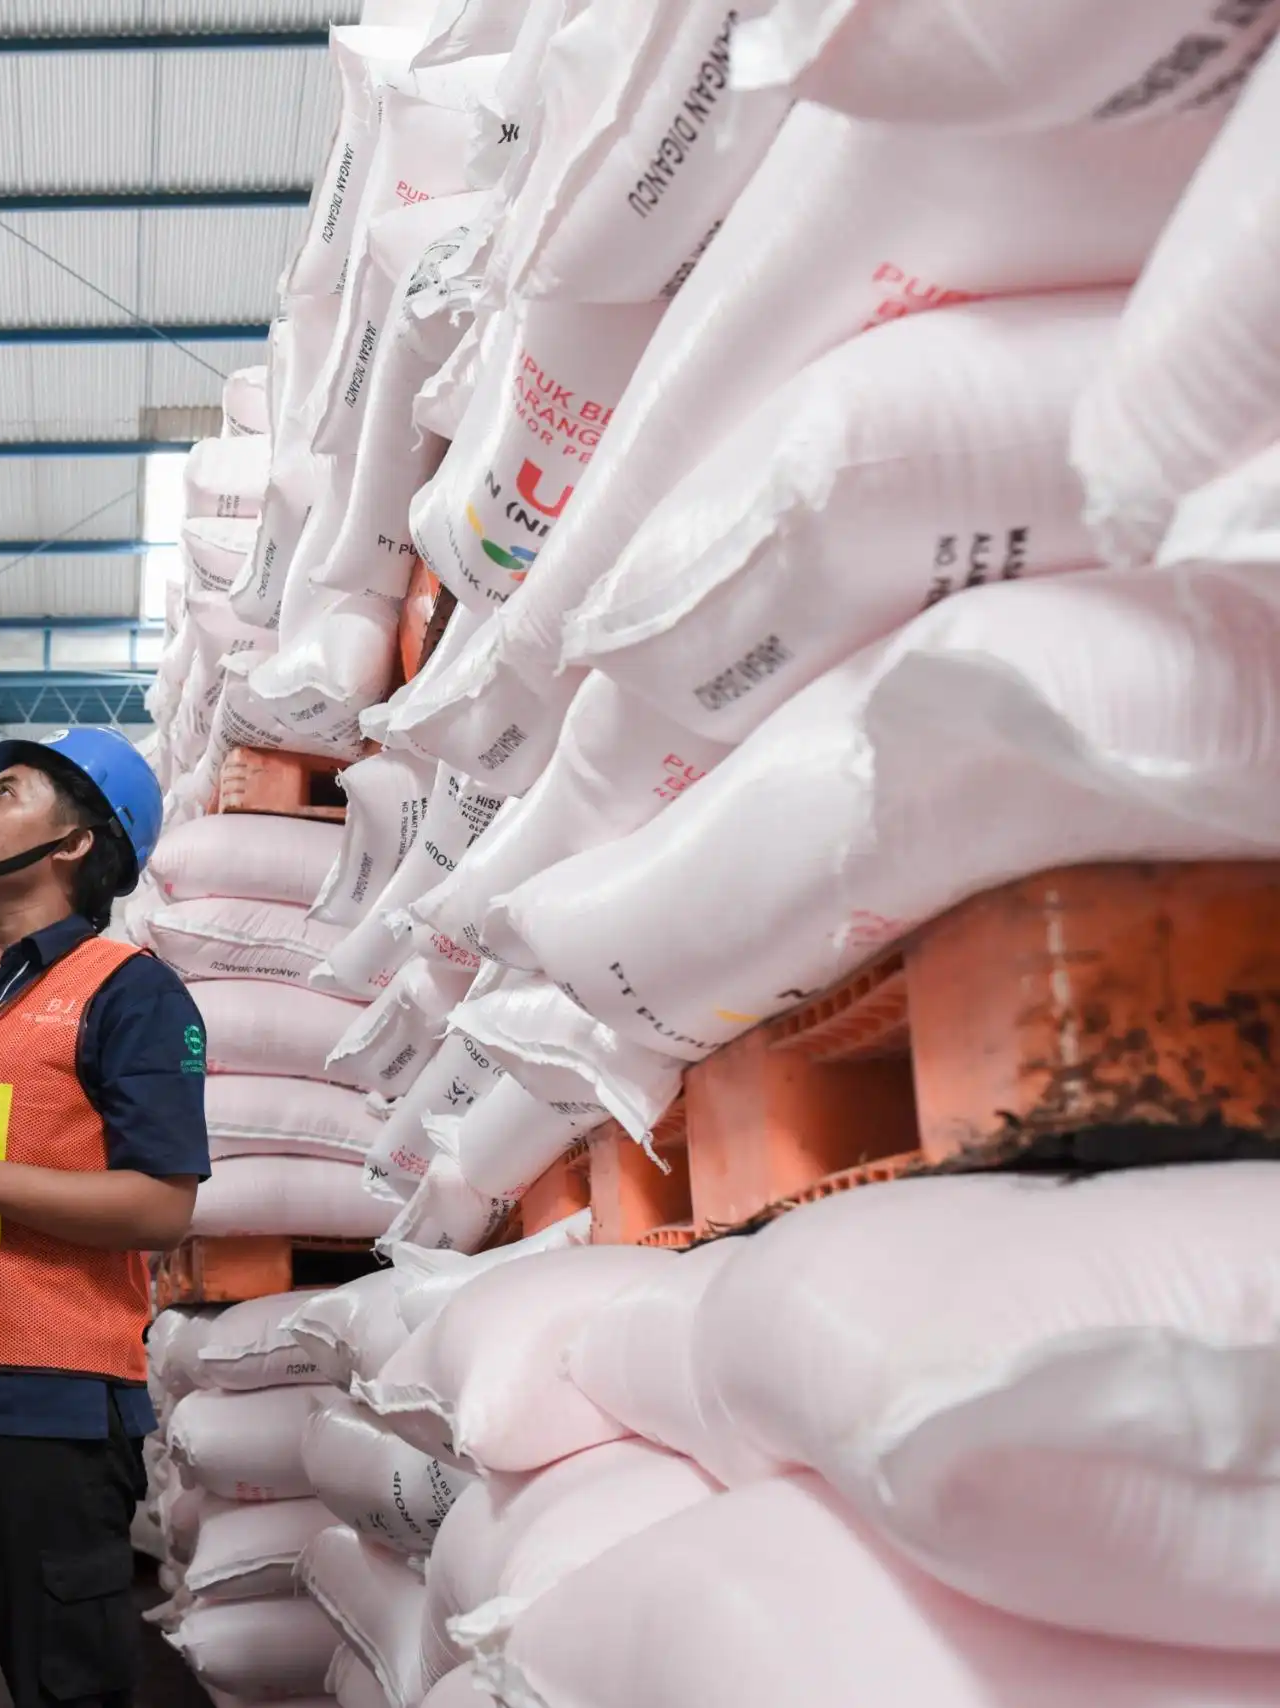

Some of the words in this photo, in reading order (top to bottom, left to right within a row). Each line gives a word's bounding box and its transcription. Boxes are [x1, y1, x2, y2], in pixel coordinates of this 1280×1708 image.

[336, 143, 355, 194] JANGAN
[627, 115, 698, 219] DIGANCU
[321, 196, 346, 244] DIGANCU
[520, 348, 574, 410] PUK
[377, 534, 395, 553] PT
[609, 960, 639, 999] PT
